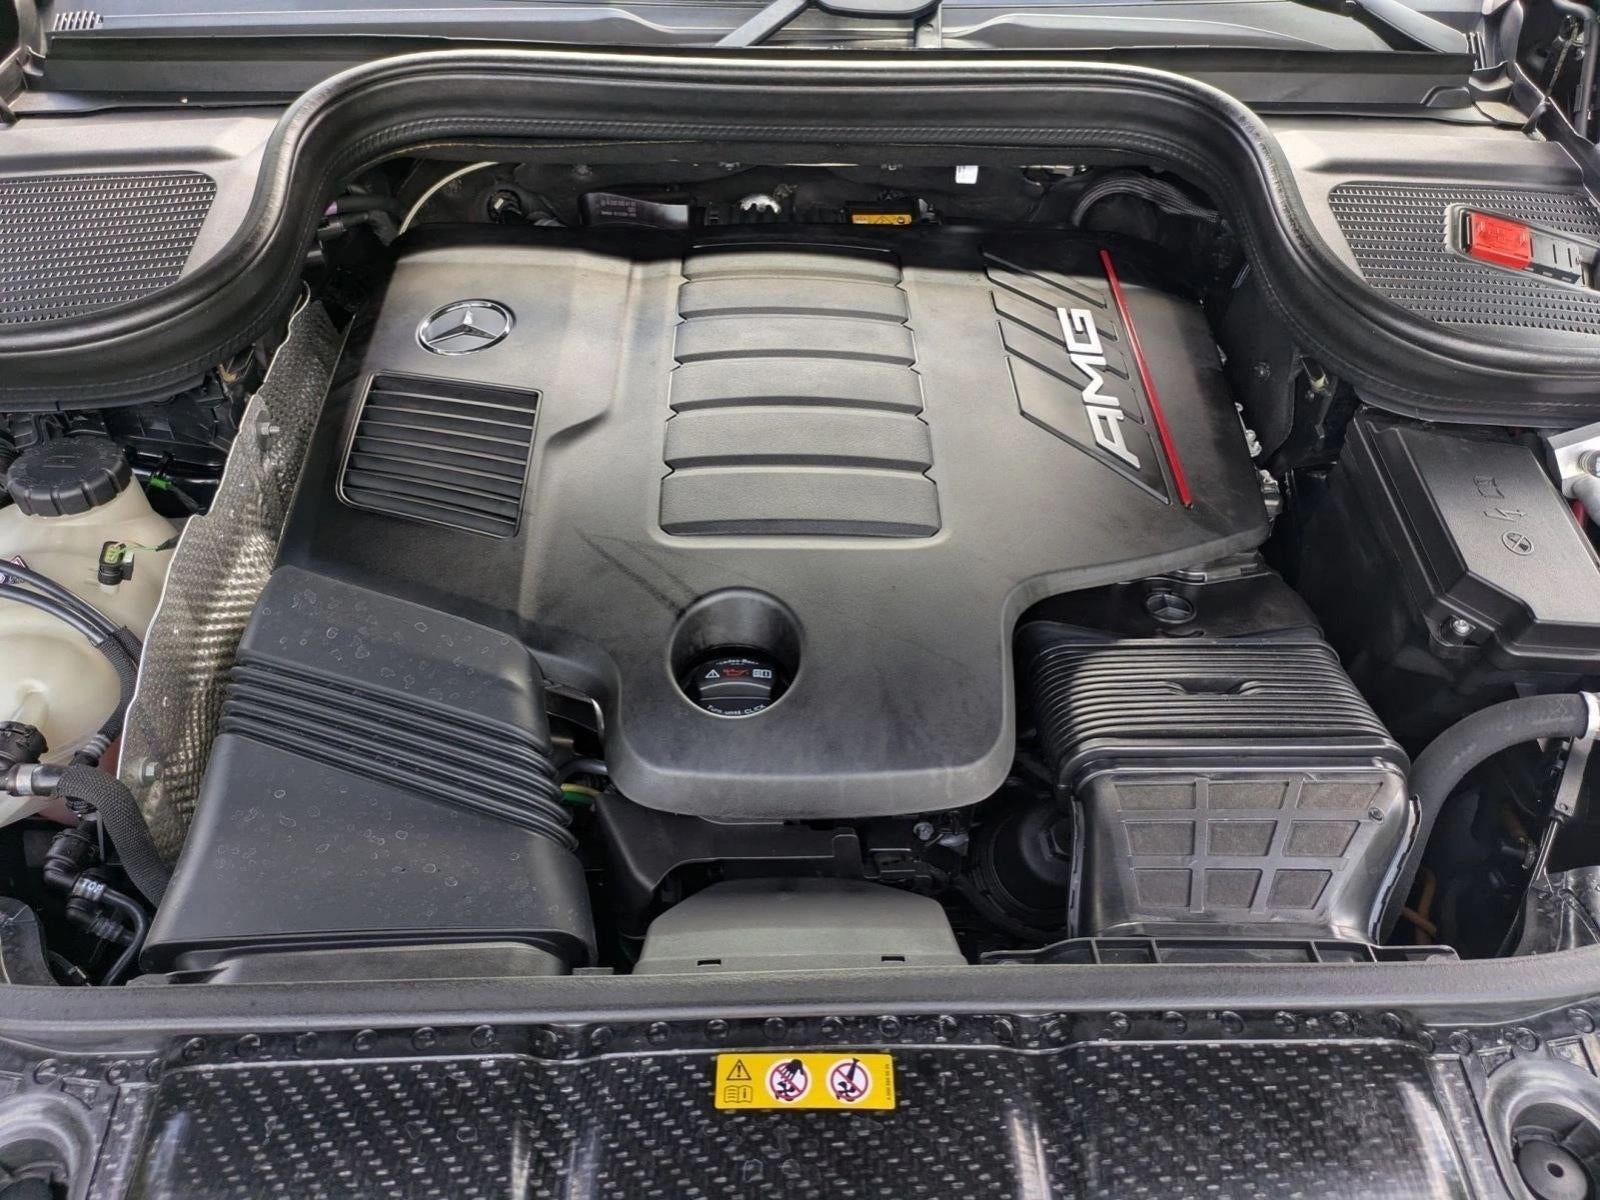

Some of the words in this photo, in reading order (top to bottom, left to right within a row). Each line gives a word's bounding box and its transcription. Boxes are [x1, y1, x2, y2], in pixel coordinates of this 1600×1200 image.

[1056, 307, 1141, 468] AMG
[707, 704, 722, 713] Turn
[744, 704, 766, 714] CLICK
[82, 878, 104, 893] TOP
